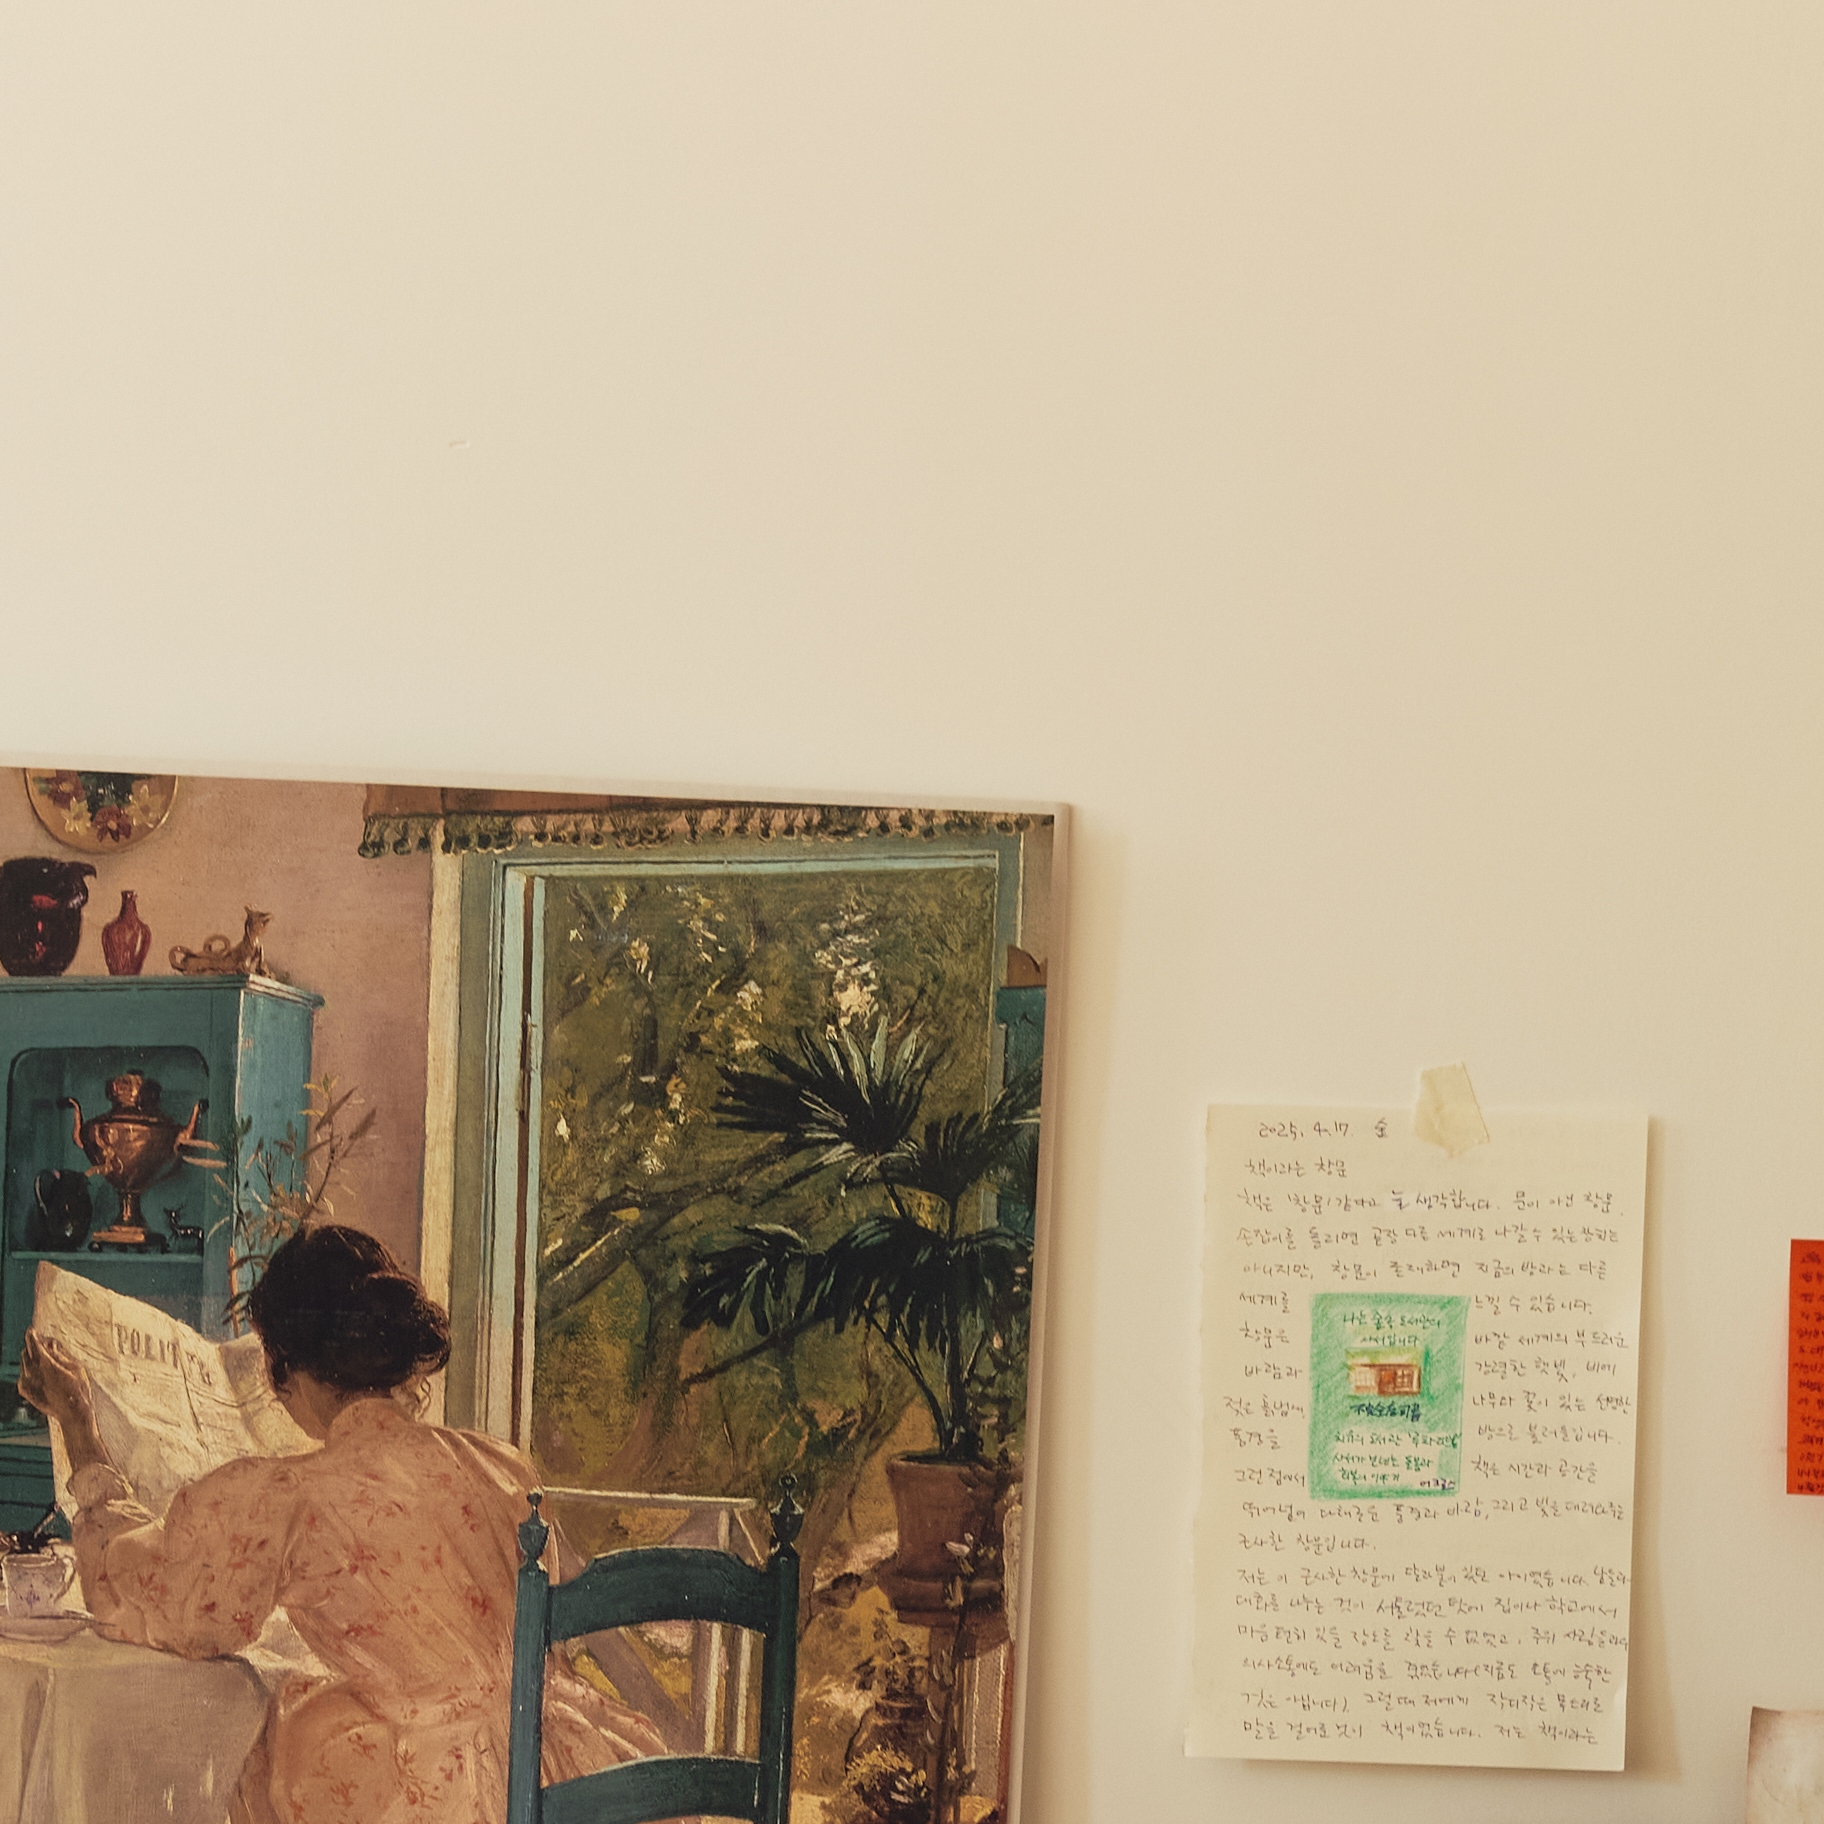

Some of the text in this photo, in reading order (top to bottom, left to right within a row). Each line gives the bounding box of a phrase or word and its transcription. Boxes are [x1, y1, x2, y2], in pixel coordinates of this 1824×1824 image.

[1244, 1155, 1347, 1179] 책이라는 창문
[1513, 1190, 1540, 1212] 문이
[1238, 1290, 1291, 1314] 세계를
[1508, 1294, 1521, 1313] 수
